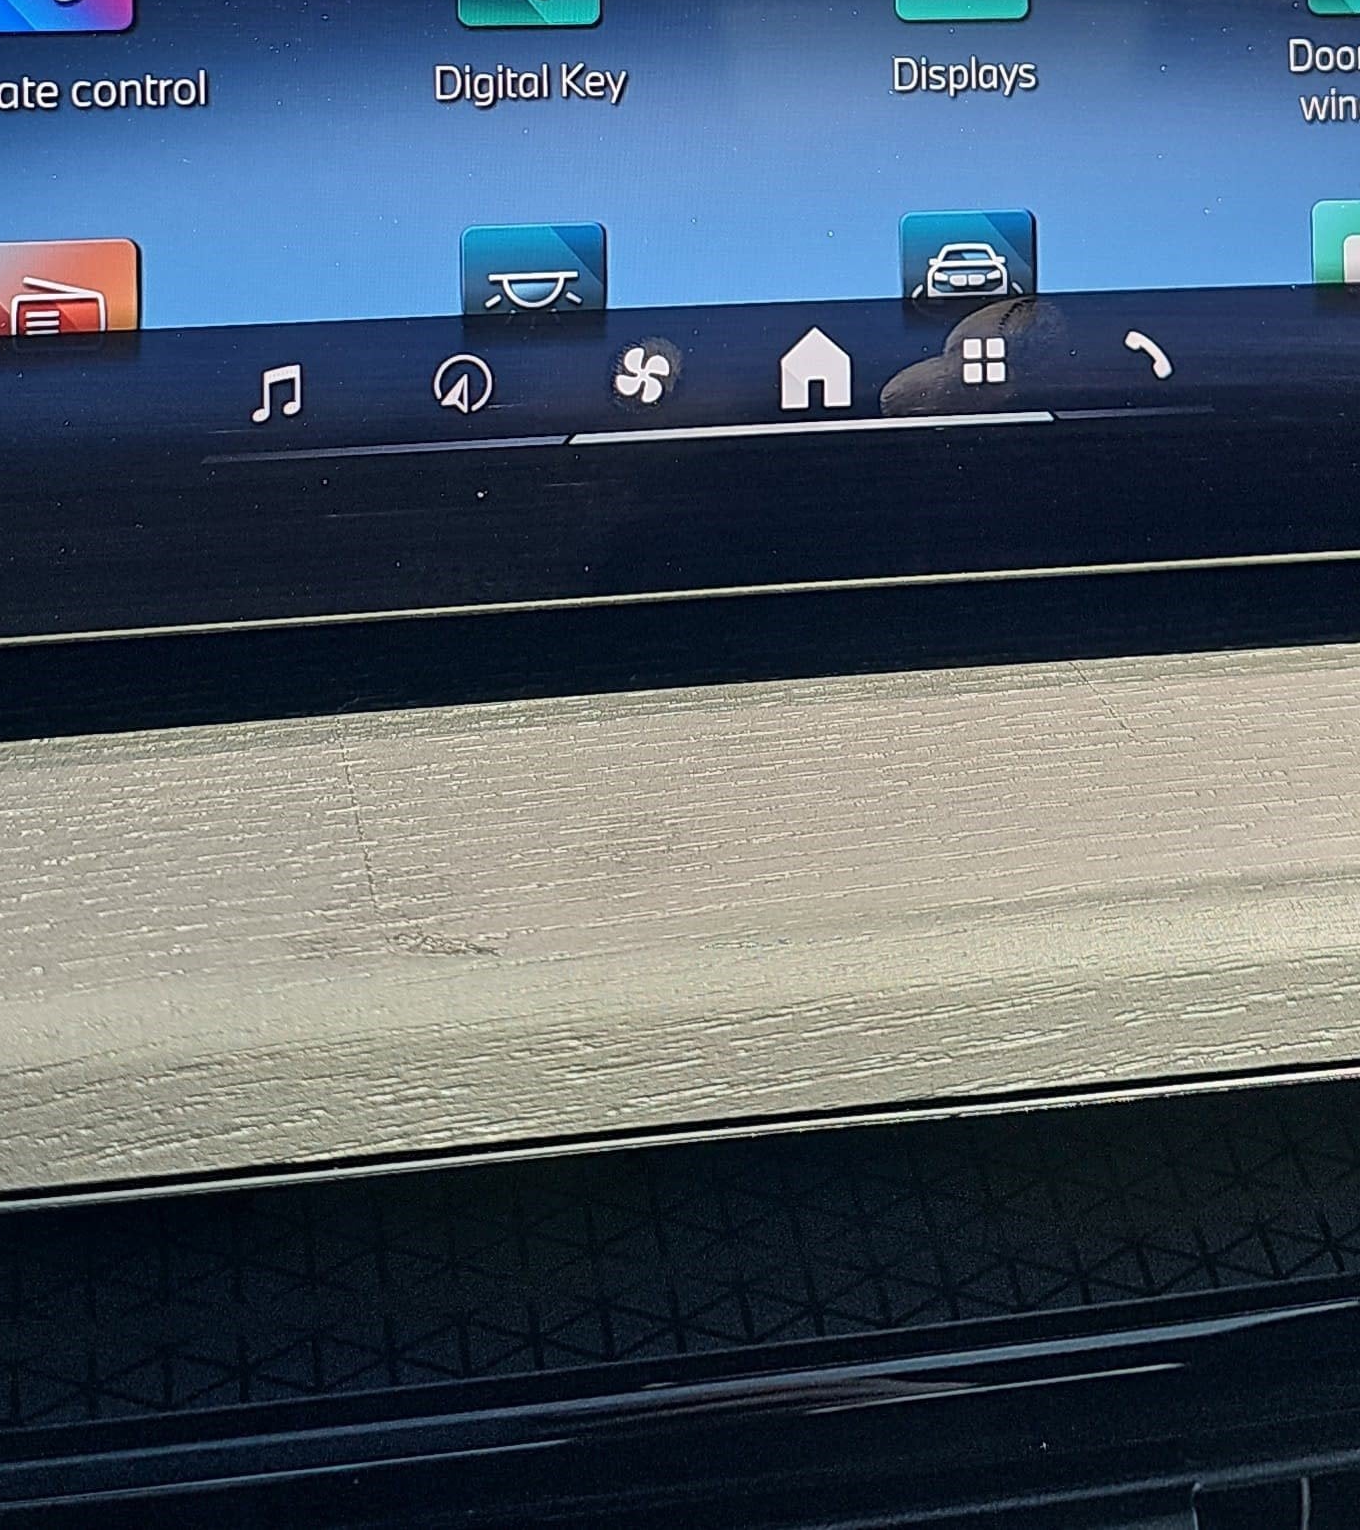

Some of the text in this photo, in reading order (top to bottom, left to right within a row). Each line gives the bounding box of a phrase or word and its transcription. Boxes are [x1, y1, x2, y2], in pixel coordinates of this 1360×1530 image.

[70, 69, 207, 108] control
[434, 62, 628, 108] Digital Key
[892, 55, 1038, 98] Displays
